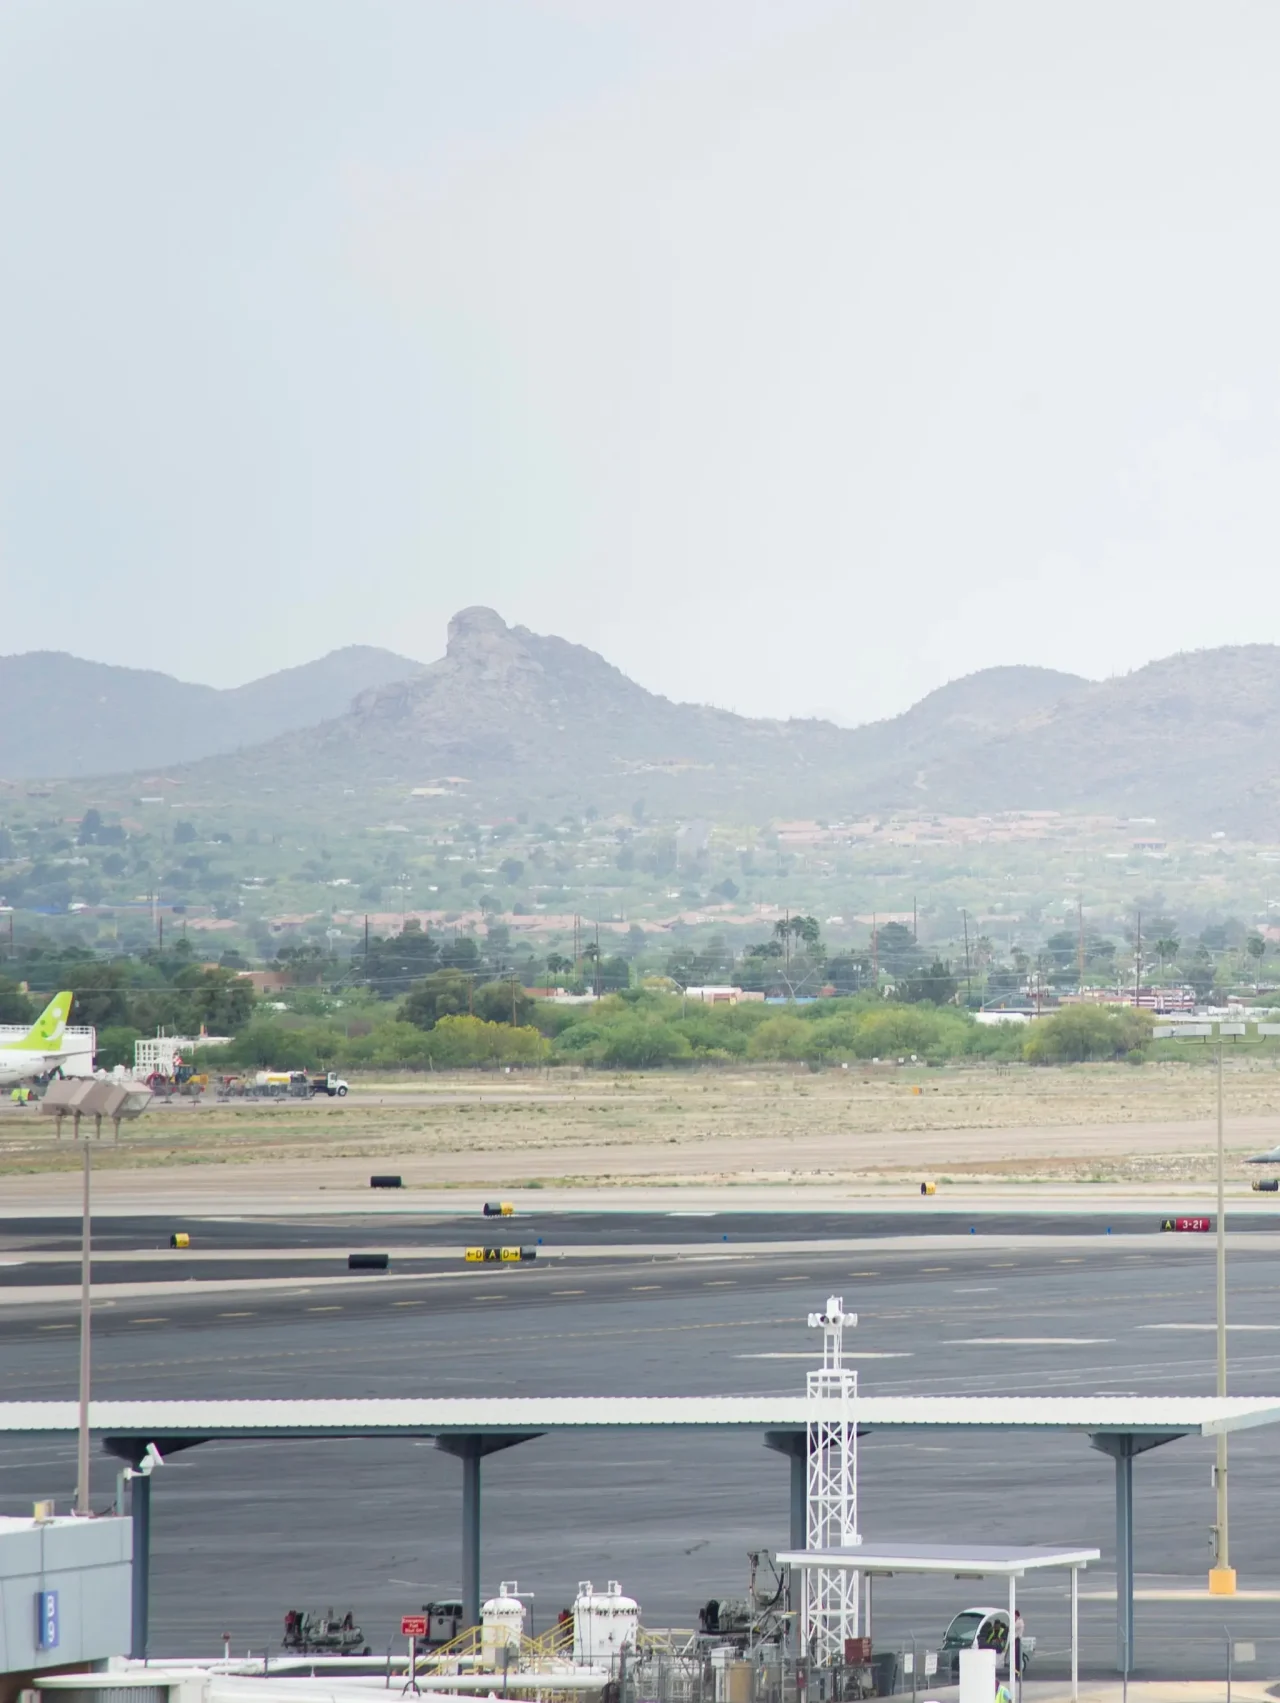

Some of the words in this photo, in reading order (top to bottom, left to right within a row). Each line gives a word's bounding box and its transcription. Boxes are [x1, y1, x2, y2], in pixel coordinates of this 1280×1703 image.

[1165, 1219, 1172, 1229] A
[1182, 1219, 1203, 1229] 3-21
[476, 1249, 483, 1259] D
[489, 1249, 497, 1259] A
[503, 1249, 510, 1259] D
